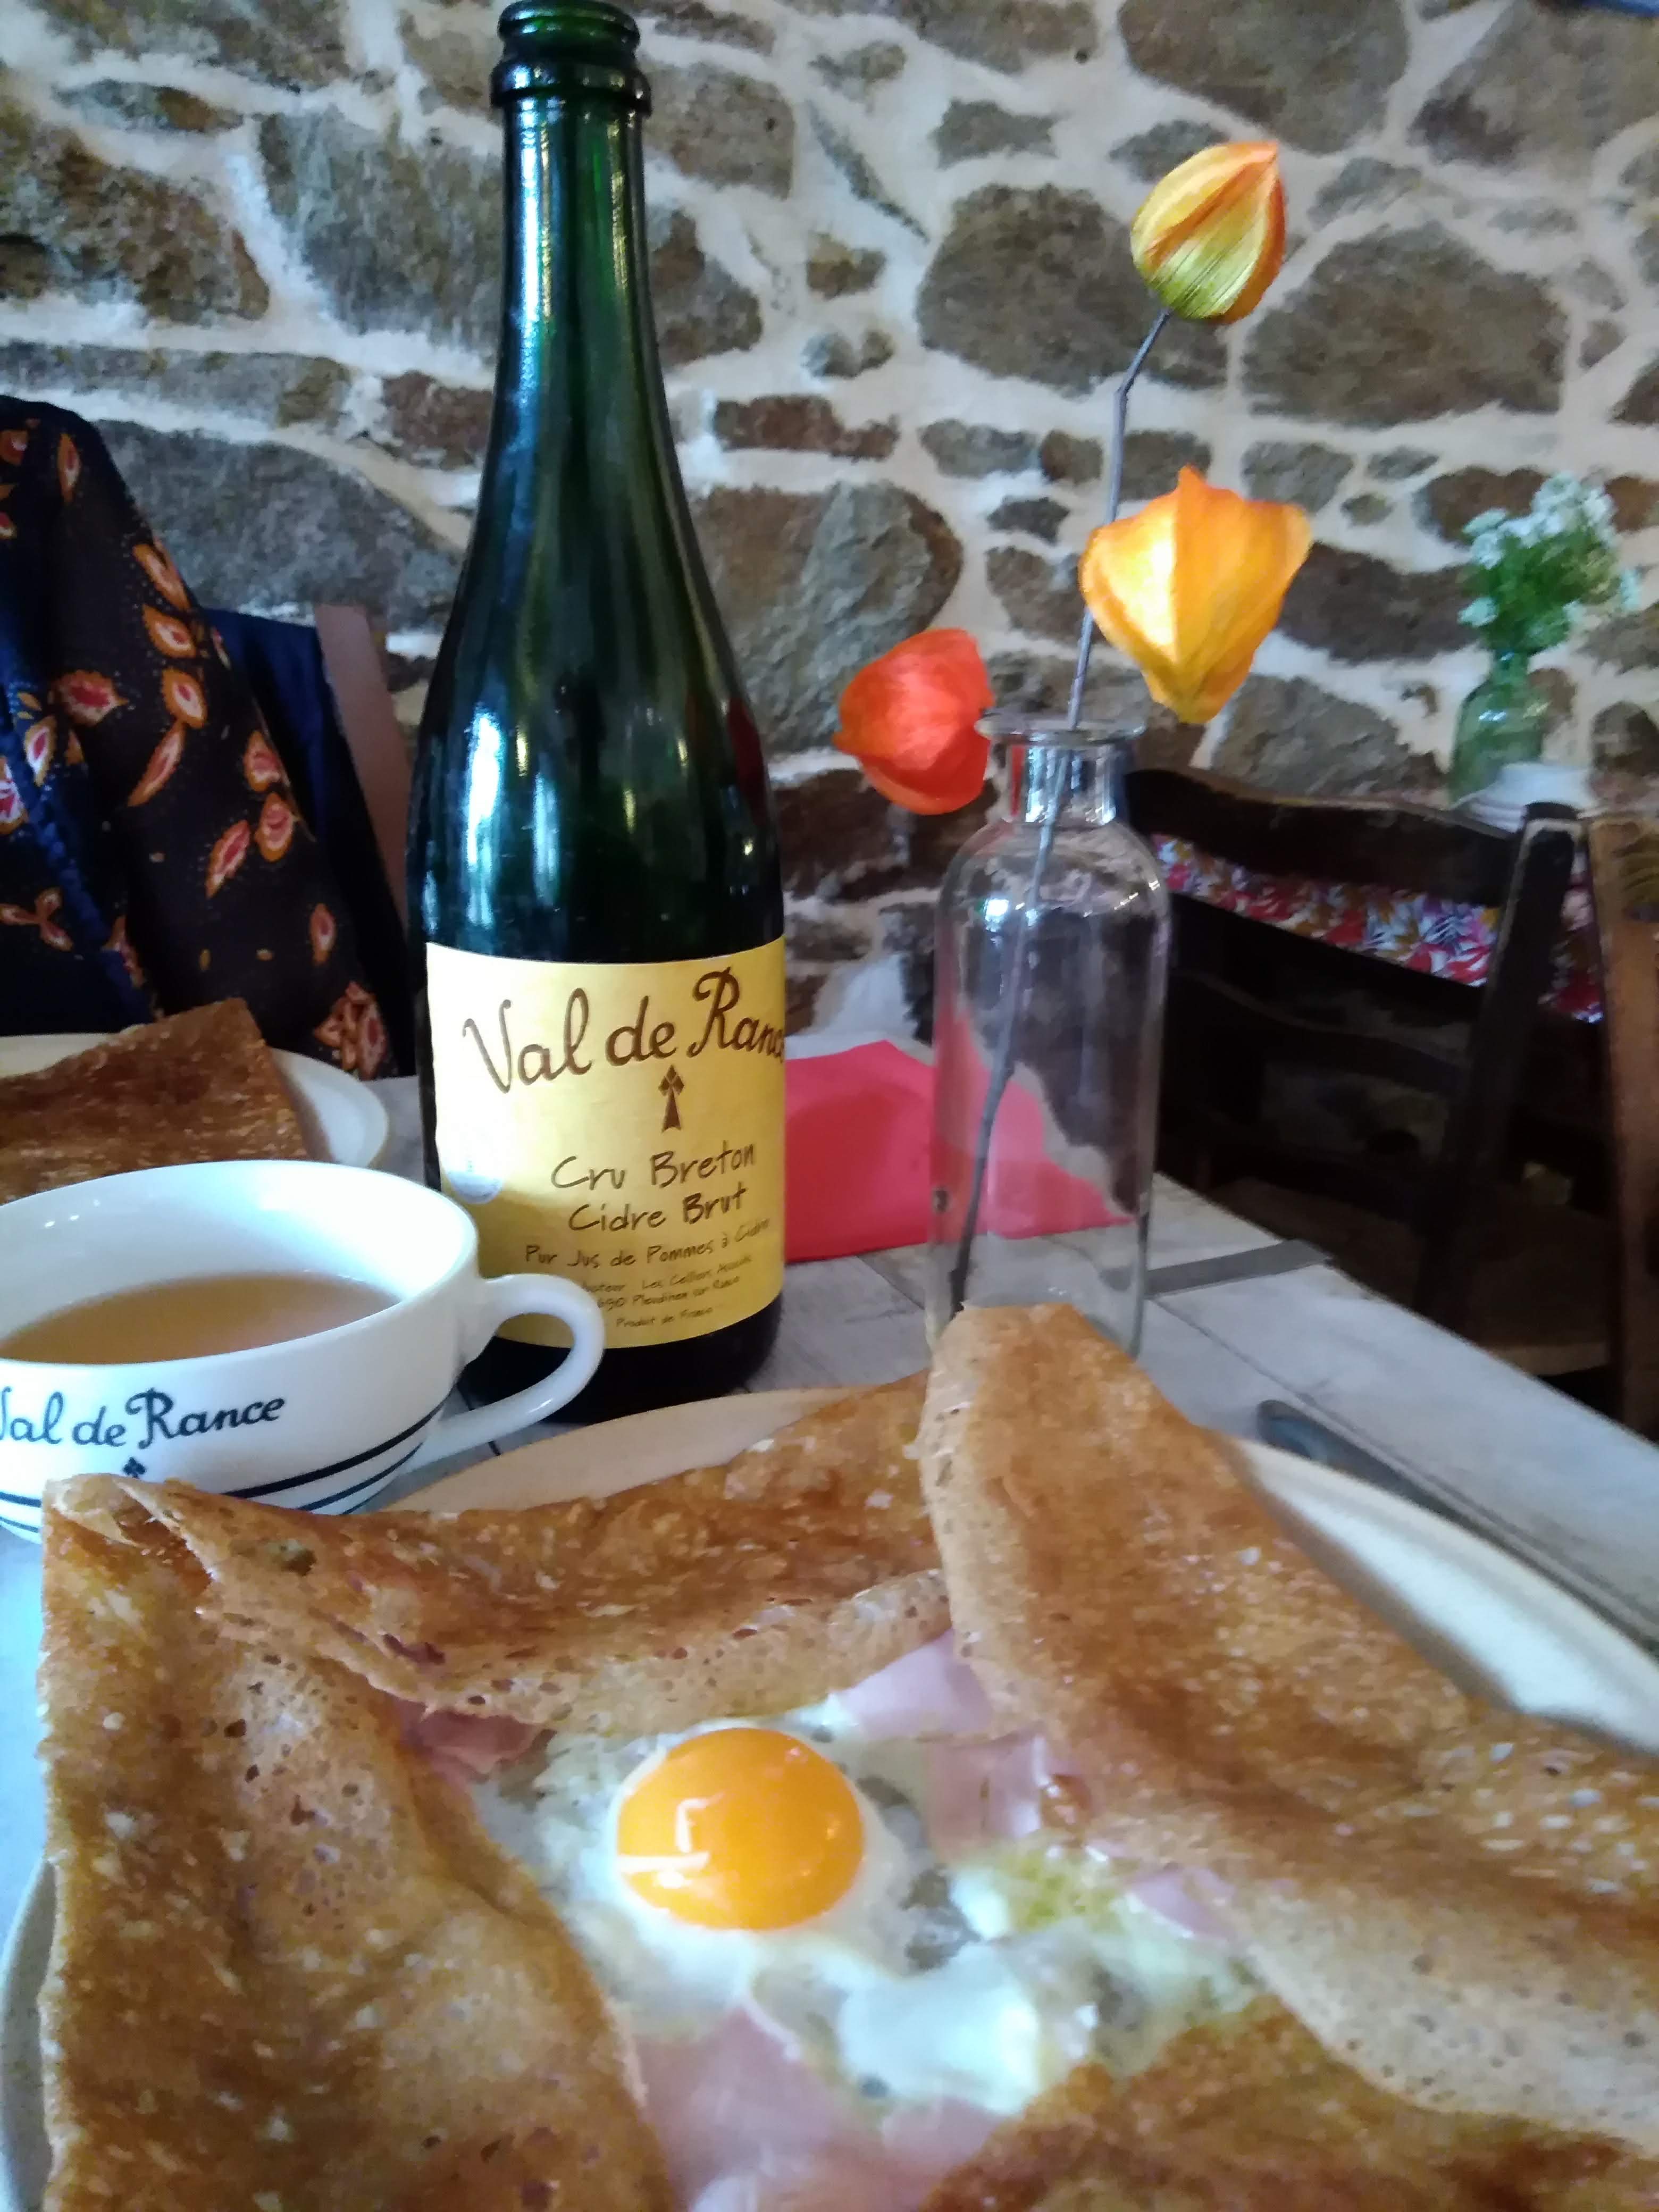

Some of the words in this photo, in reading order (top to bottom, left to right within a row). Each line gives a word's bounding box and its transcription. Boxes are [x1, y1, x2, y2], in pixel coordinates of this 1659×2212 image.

[463, 988, 592, 1093] Val
[606, 995, 677, 1066] de
[551, 1156, 625, 1191] Cru
[650, 1139, 755, 1188] Breton
[568, 1203, 666, 1231] Cidre
[683, 1182, 747, 1224] Brut
[526, 1245, 558, 1263] Pur
[567, 1250, 600, 1269] Jus
[610, 1250, 636, 1266] de
[647, 1239, 714, 1263] Pommes
[72, 1405, 126, 1447] de
[125, 1387, 285, 1449] Rance
